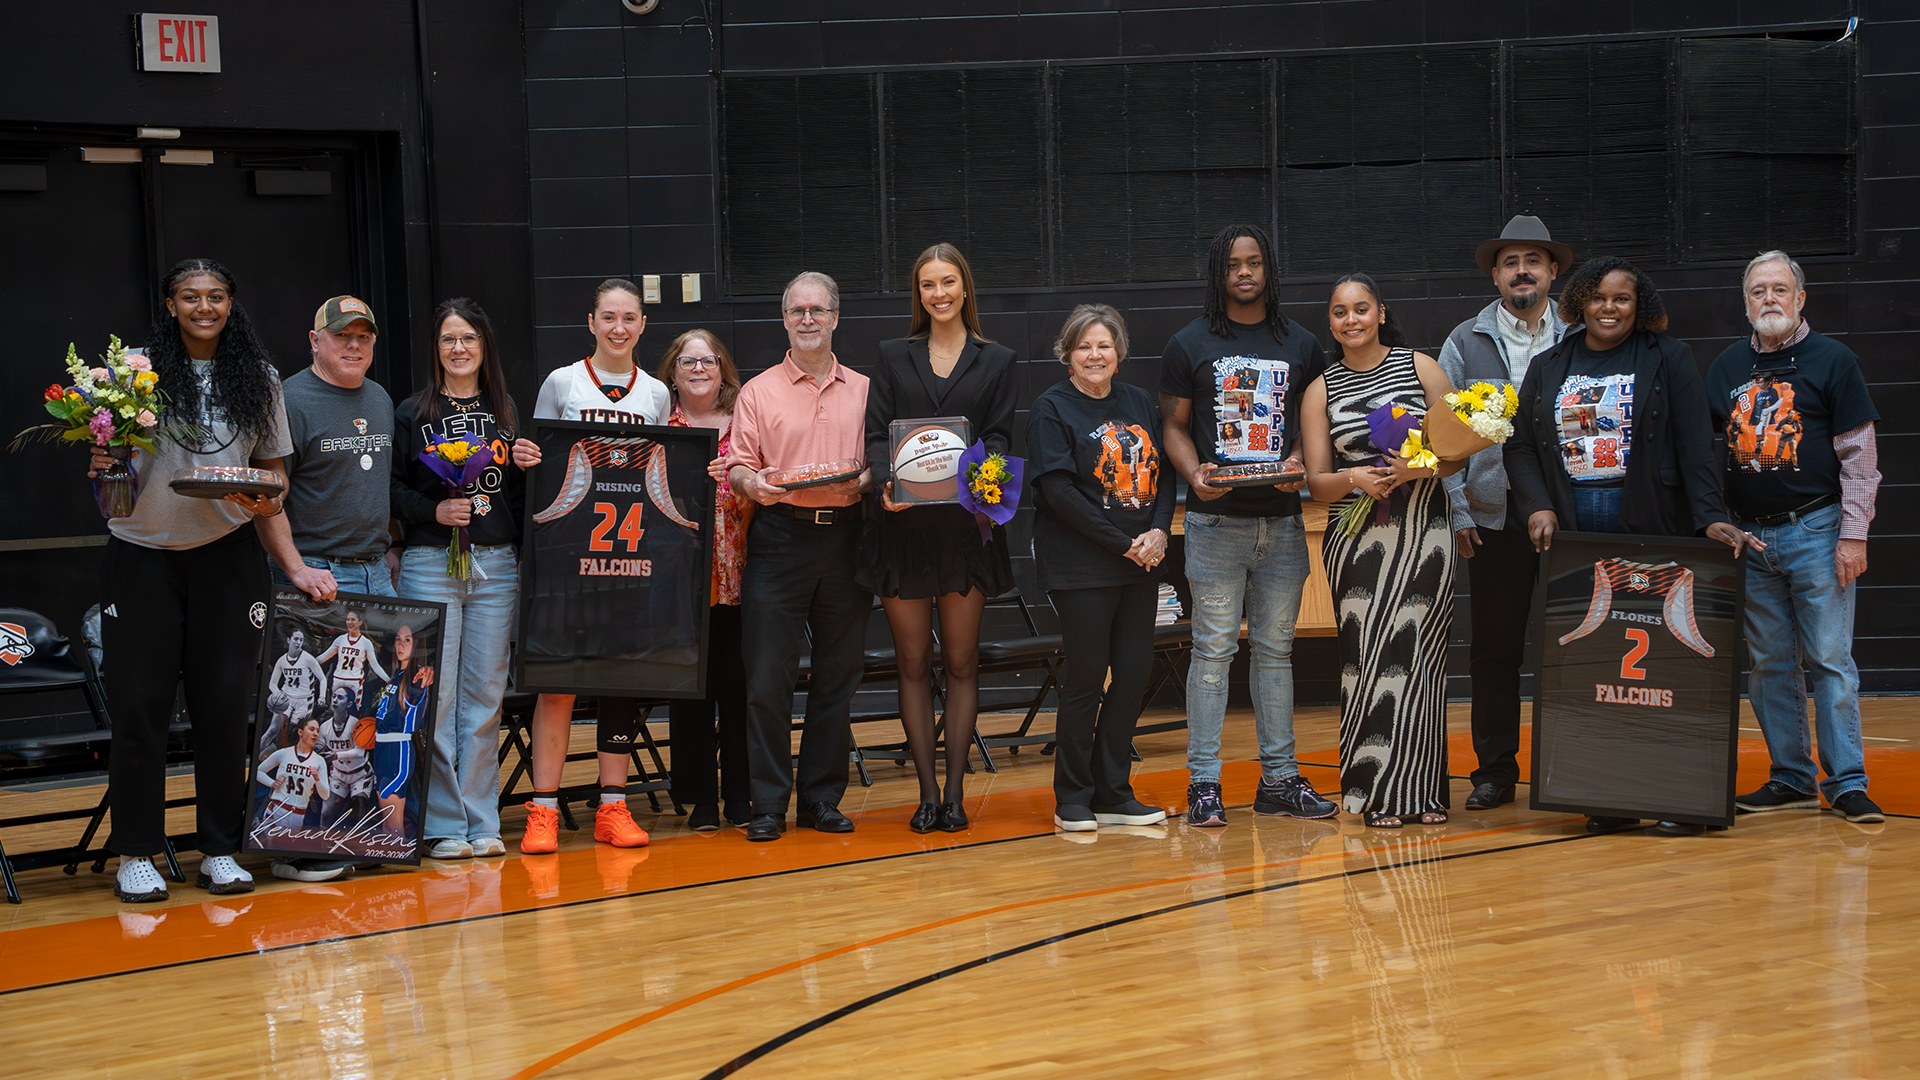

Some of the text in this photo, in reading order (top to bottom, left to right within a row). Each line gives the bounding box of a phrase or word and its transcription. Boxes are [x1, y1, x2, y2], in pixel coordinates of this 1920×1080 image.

[158, 19, 207, 63] EXIT
[1269, 368, 1288, 454] UTPB
[595, 482, 641, 493] RISING
[589, 502, 645, 552] 24
[579, 558, 652, 577] FALCONS
[373, 603, 438, 615] Basketball
[1611, 610, 1662, 626] FLORES
[341, 647, 360, 657] UTPB
[1620, 628, 1650, 680] 2
[341, 656, 355, 671] 24
[1595, 684, 1673, 707] FALCONS
